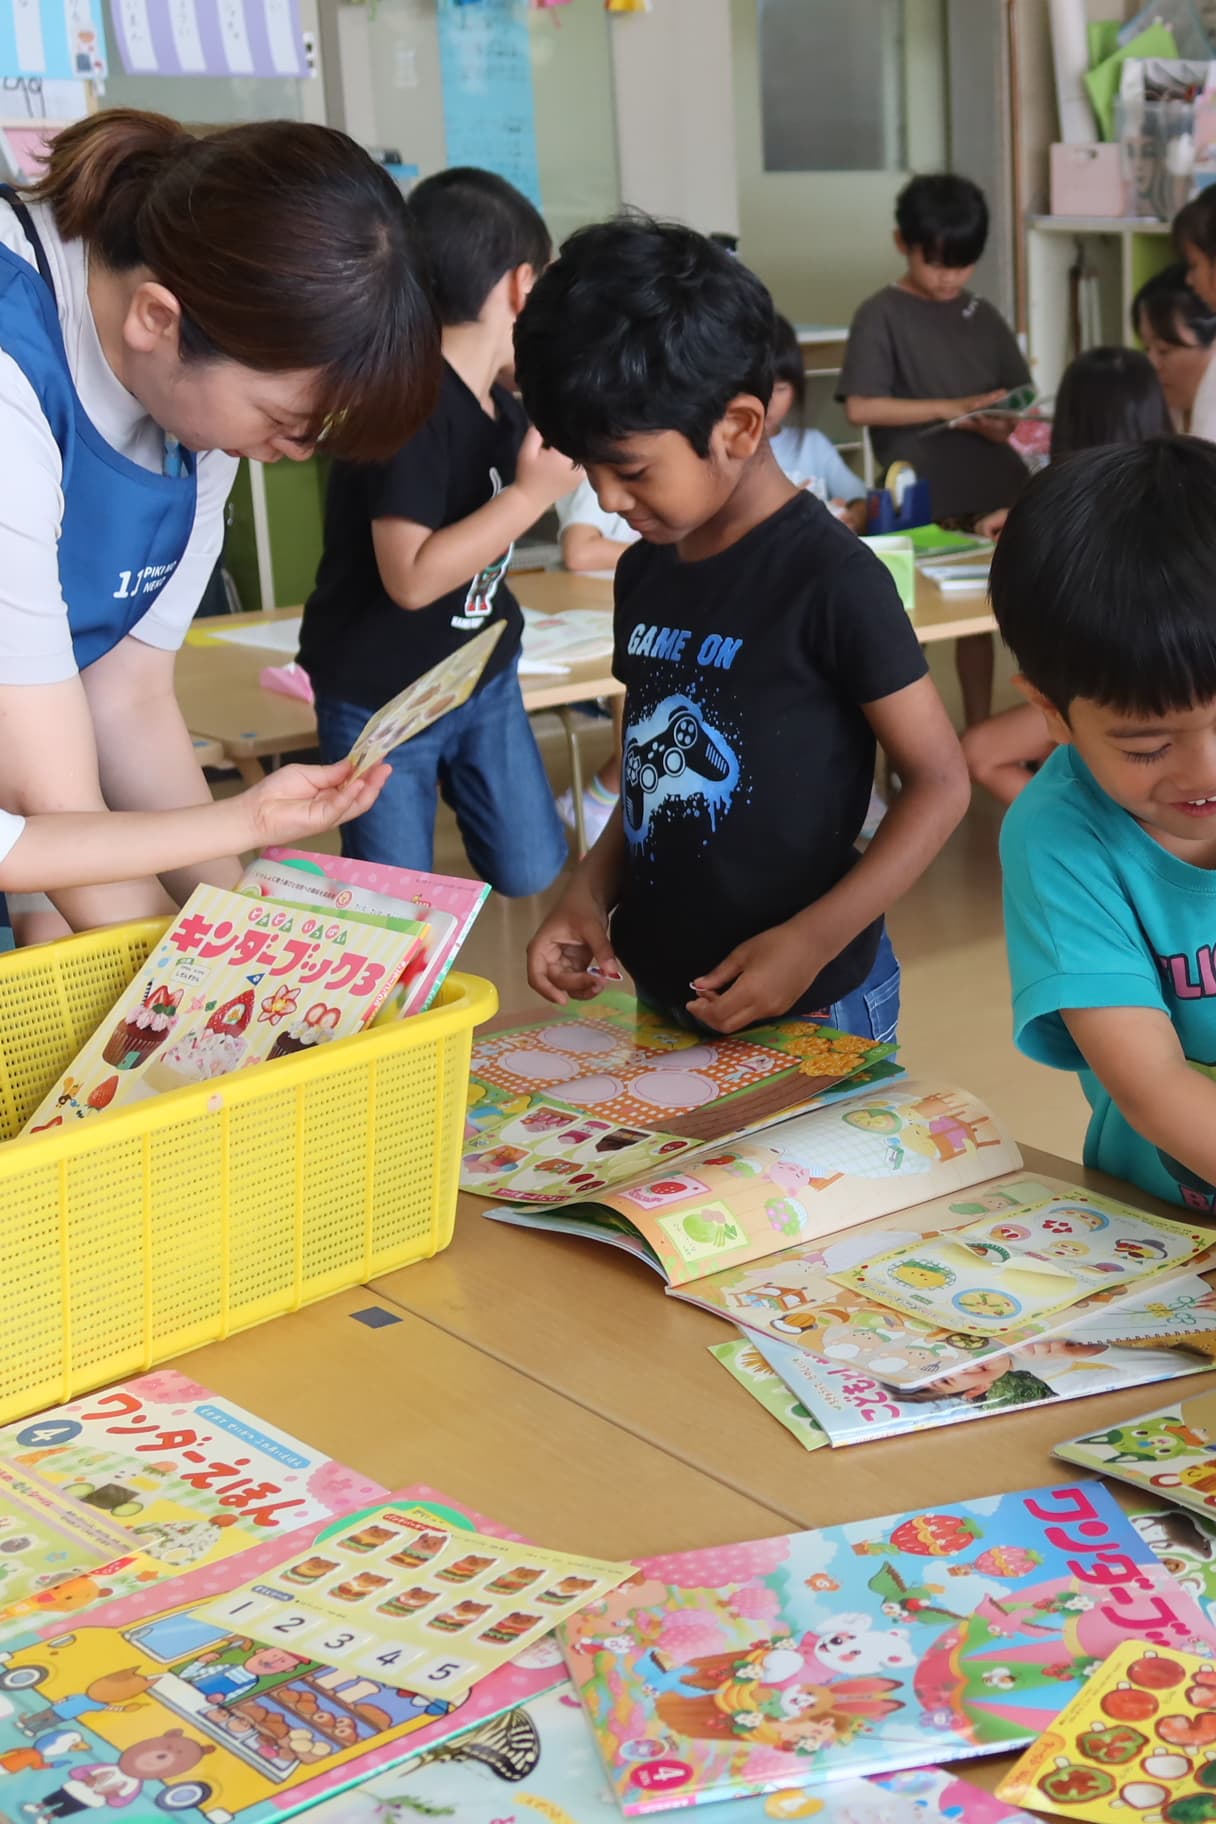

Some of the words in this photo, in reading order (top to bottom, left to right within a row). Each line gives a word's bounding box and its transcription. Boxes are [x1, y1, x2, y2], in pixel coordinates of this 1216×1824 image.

[627, 623, 692, 662] GAME
[697, 634, 743, 669] ON
[170, 913, 386, 997] キンダーブック3
[32, 1424, 71, 1443] 4
[81, 1392, 306, 1527] ワンダーえほん
[229, 1601, 254, 1615] 1
[273, 1617, 305, 1633] 2
[324, 1633, 354, 1649] 3
[376, 1649, 402, 1666] 4
[428, 1663, 459, 1680] 5
[652, 1766, 686, 1782] 4
